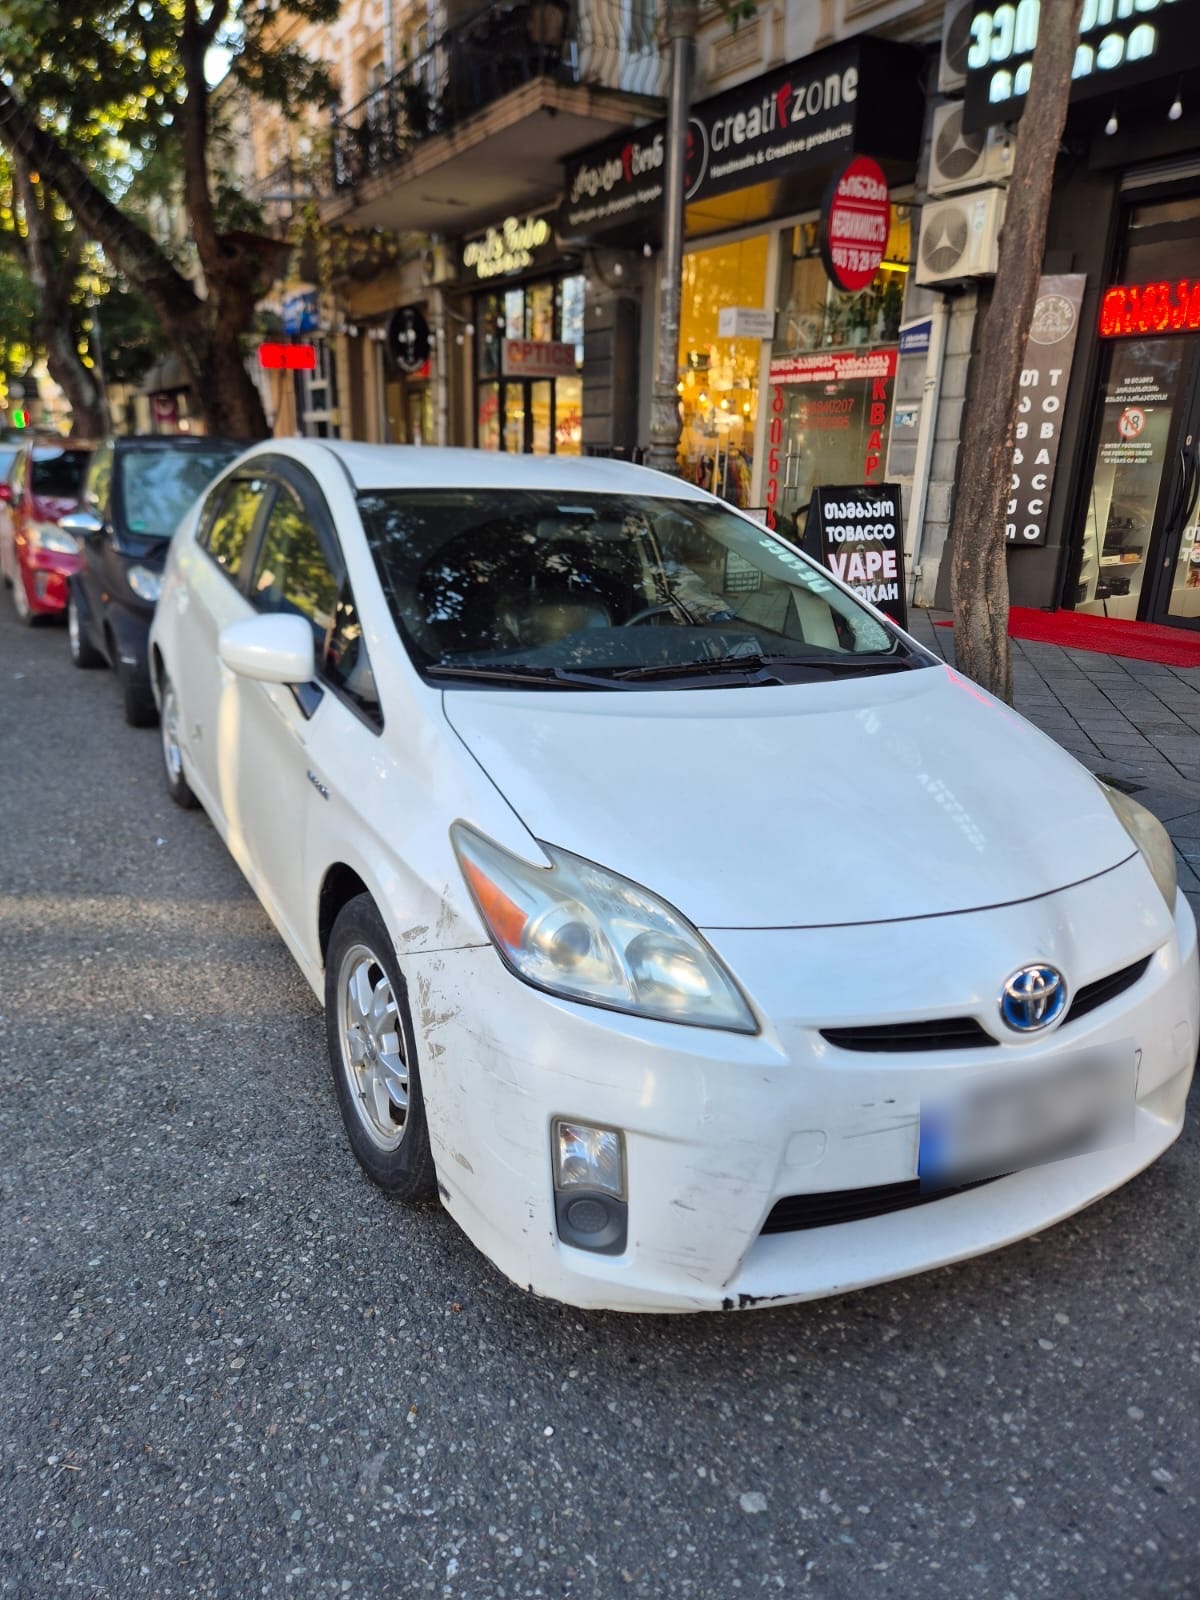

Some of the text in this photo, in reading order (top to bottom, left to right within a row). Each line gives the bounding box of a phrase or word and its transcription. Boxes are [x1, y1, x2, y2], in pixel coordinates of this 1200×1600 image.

[765, 139, 806, 162] Creative
[806, 123, 854, 152] products
[1023, 369, 1063, 540] TOBACCO
[824, 500, 895, 519] თამბაქო
[825, 523, 896, 543] TOBACCO
[827, 549, 898, 582] VAPE
